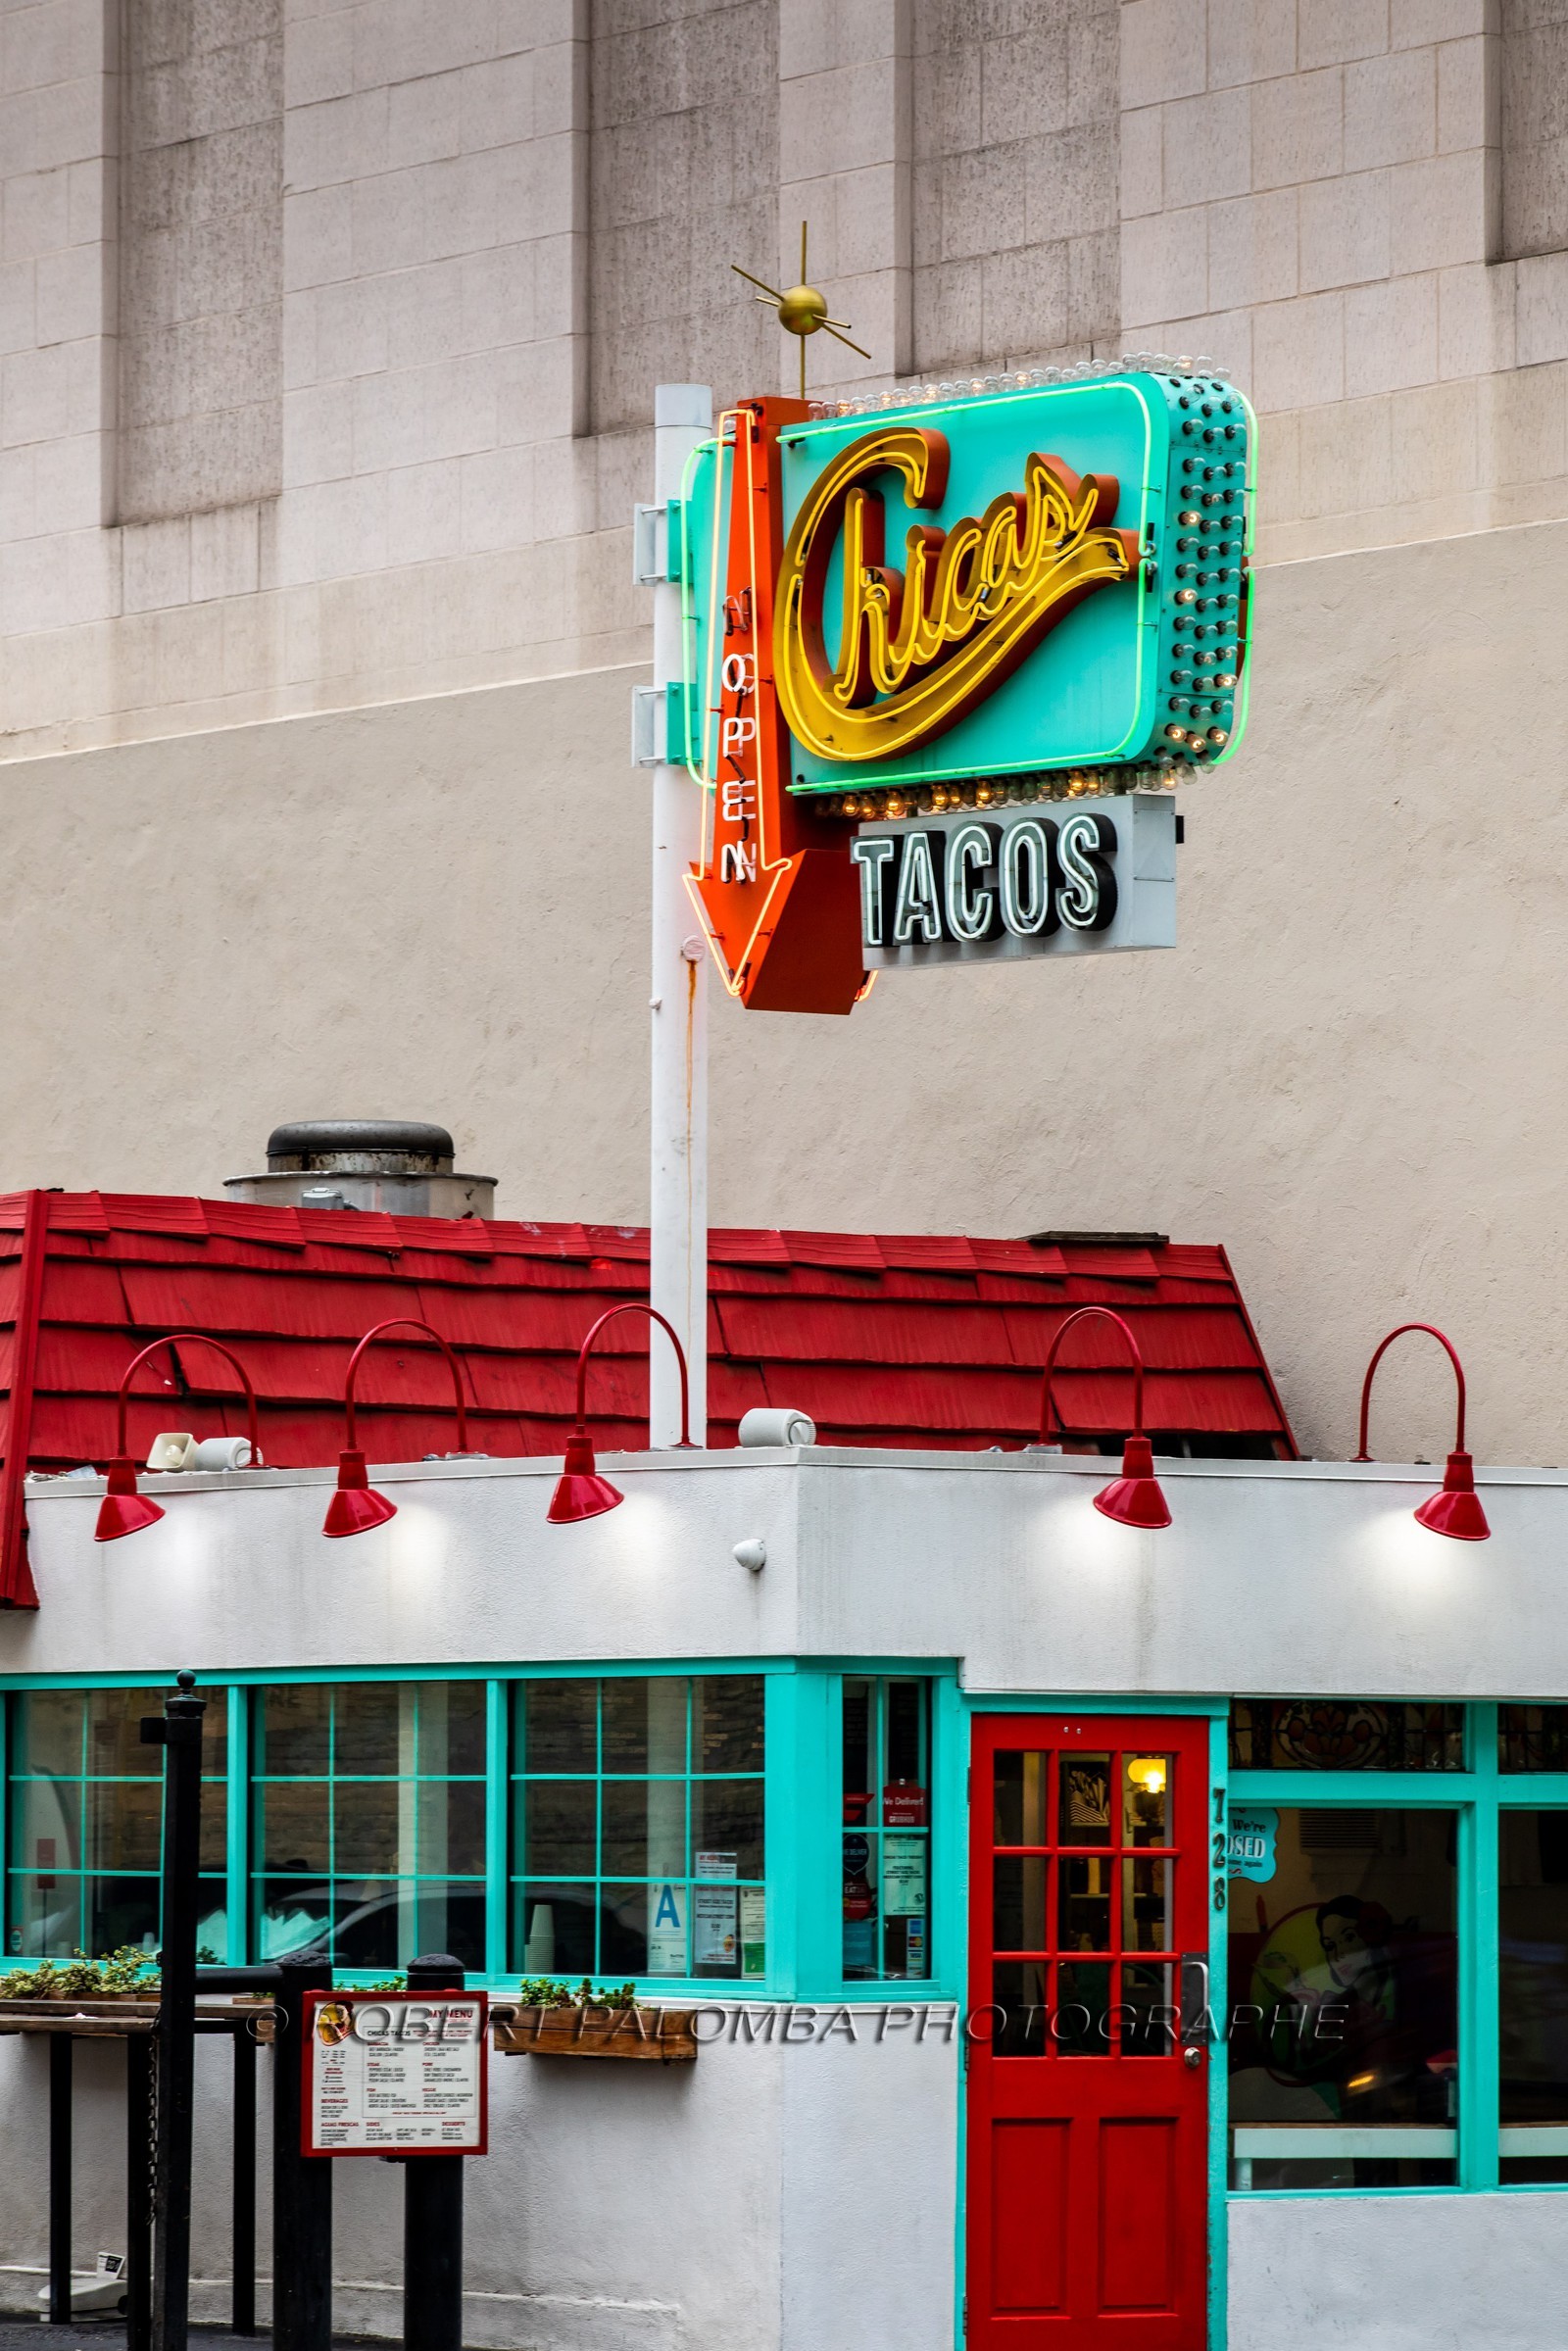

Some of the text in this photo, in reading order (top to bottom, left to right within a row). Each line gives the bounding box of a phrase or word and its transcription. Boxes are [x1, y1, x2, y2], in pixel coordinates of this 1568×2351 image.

[774, 427, 1134, 762] Chicas
[851, 812, 1118, 948] TACOS
[1227, 1835, 1266, 1859] OSED
[1232, 1819, 1266, 1834] We're
[1212, 1787, 1226, 1911] 728
[655, 1884, 681, 1928] A
[447, 2009, 473, 2018] MENU
